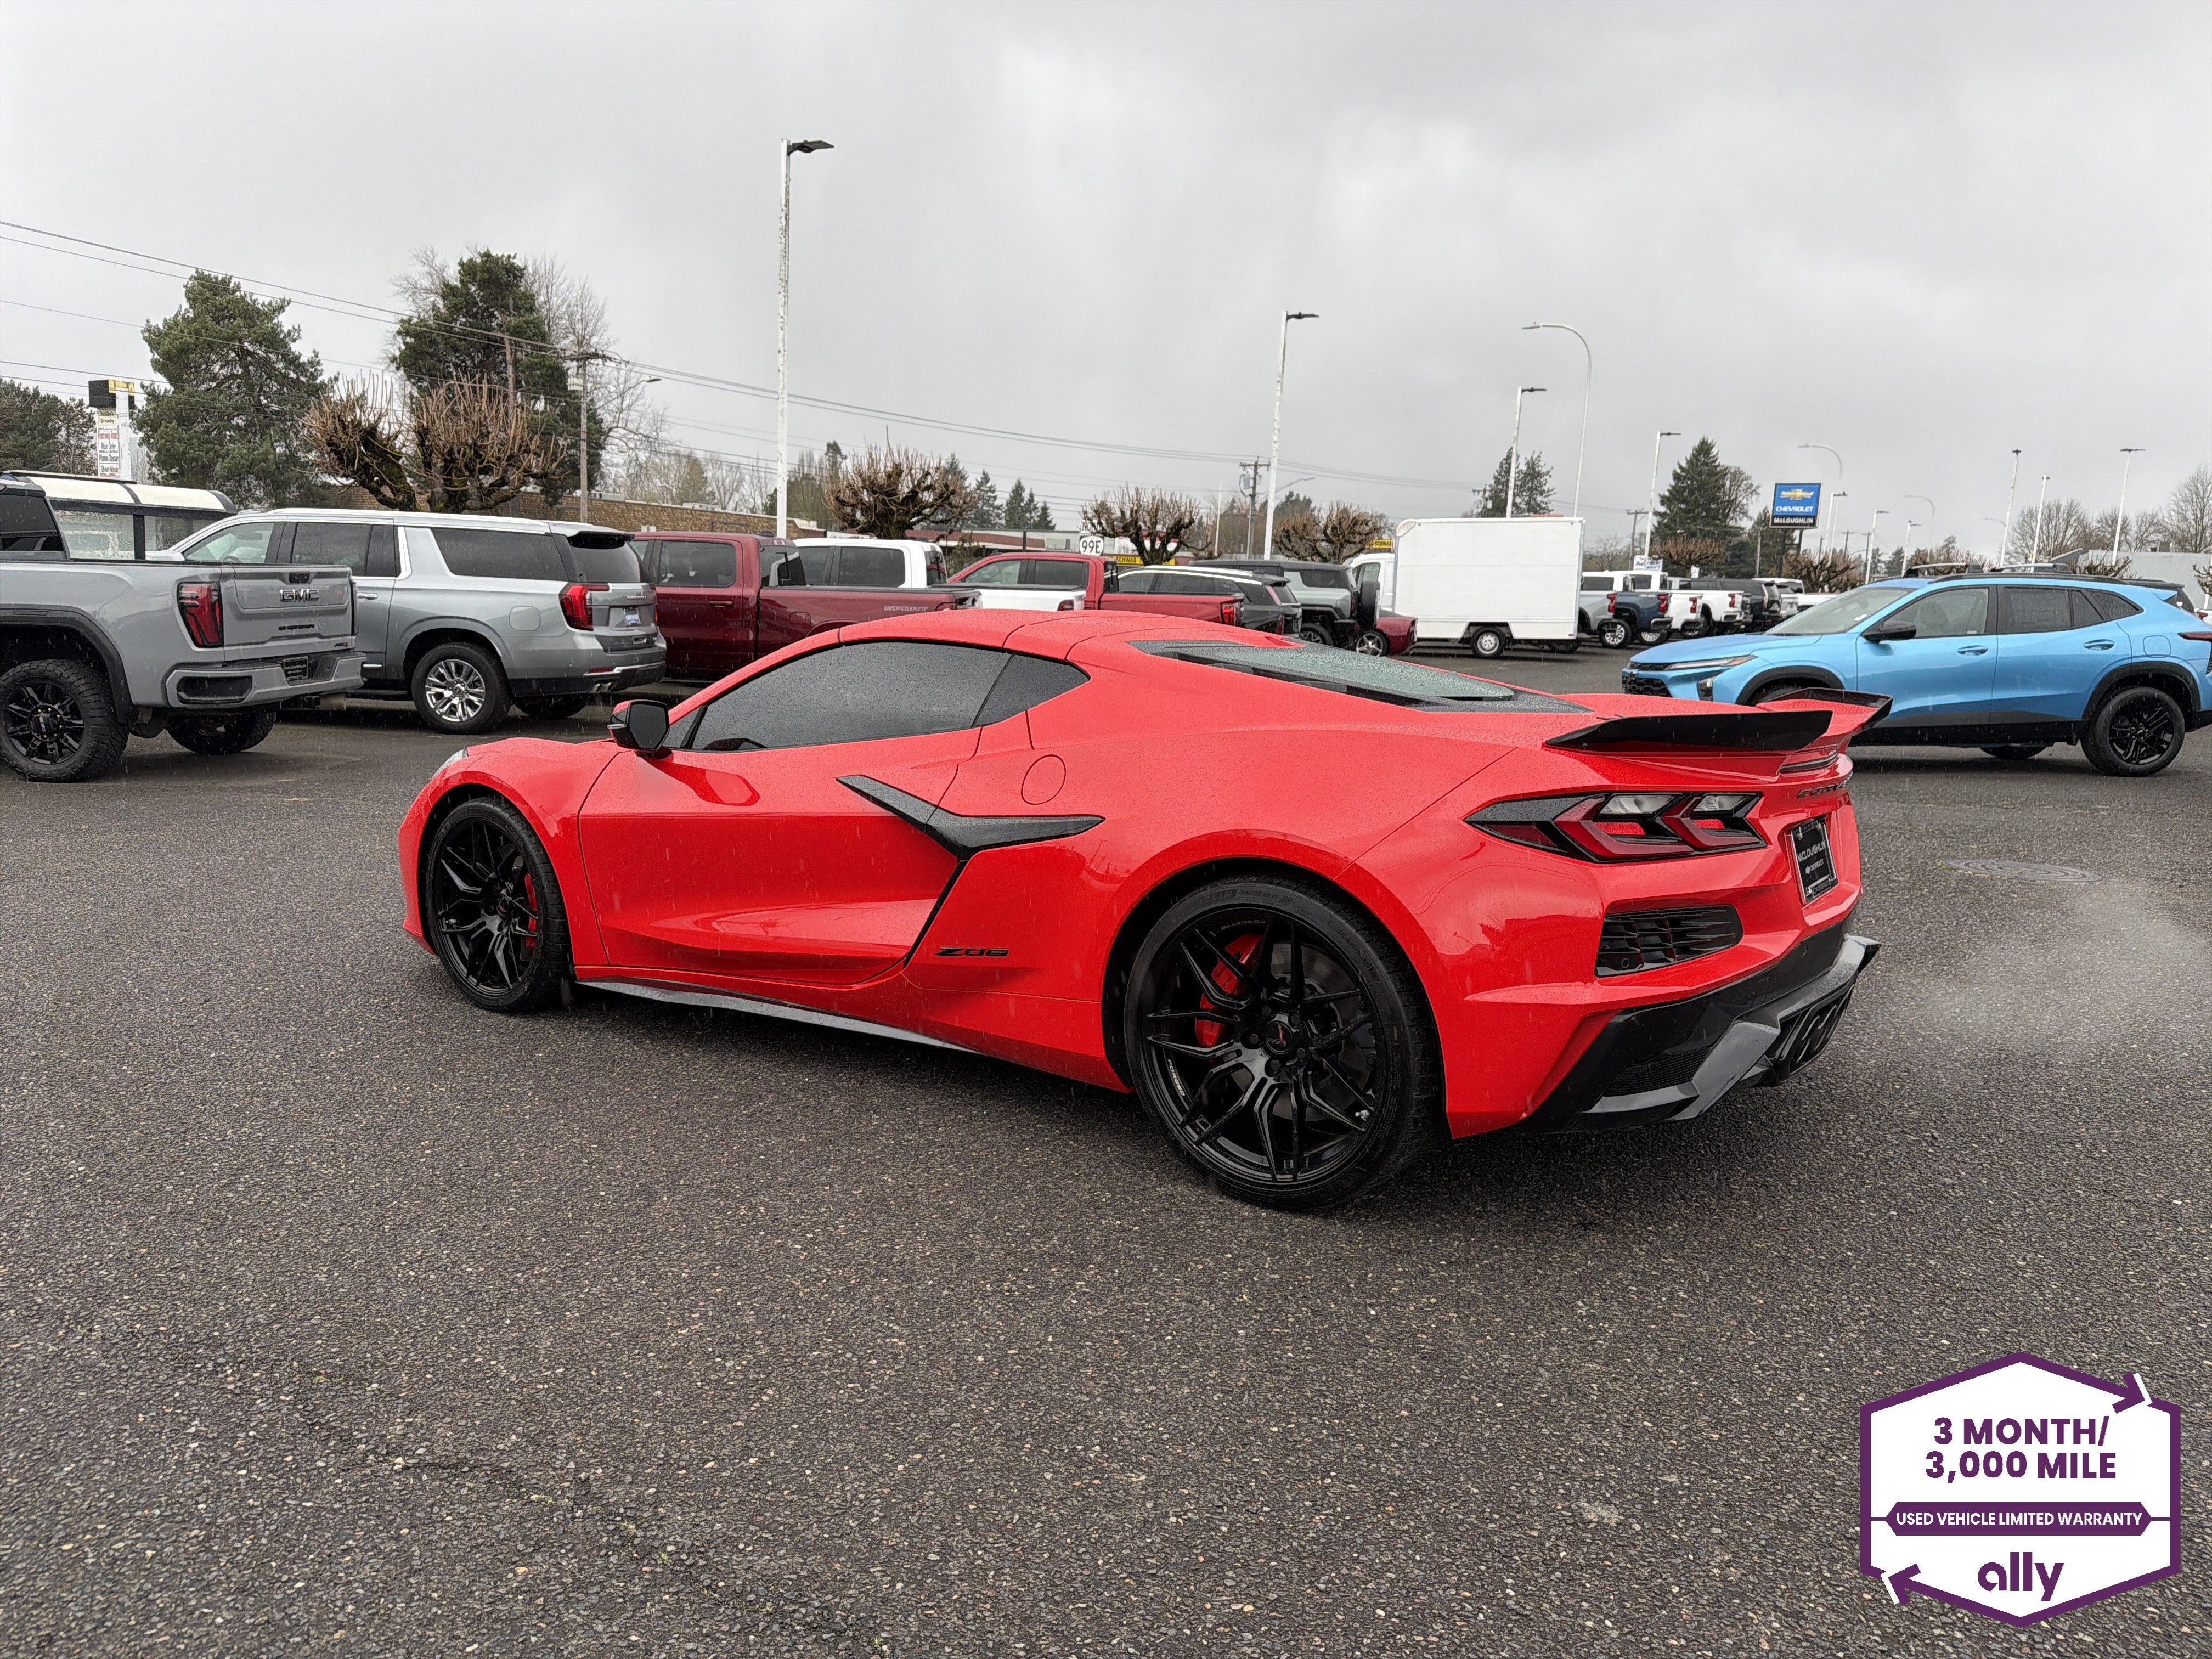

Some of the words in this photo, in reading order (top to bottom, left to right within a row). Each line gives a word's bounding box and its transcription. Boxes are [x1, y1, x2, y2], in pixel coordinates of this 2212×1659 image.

[1082, 540, 1101, 554] 99E
[280, 589, 319, 602] GMC
[1221, 919, 1265, 930] CORVETTE
[934, 947, 1009, 957] Z06
[1167, 1059, 1186, 1096] FORGED
